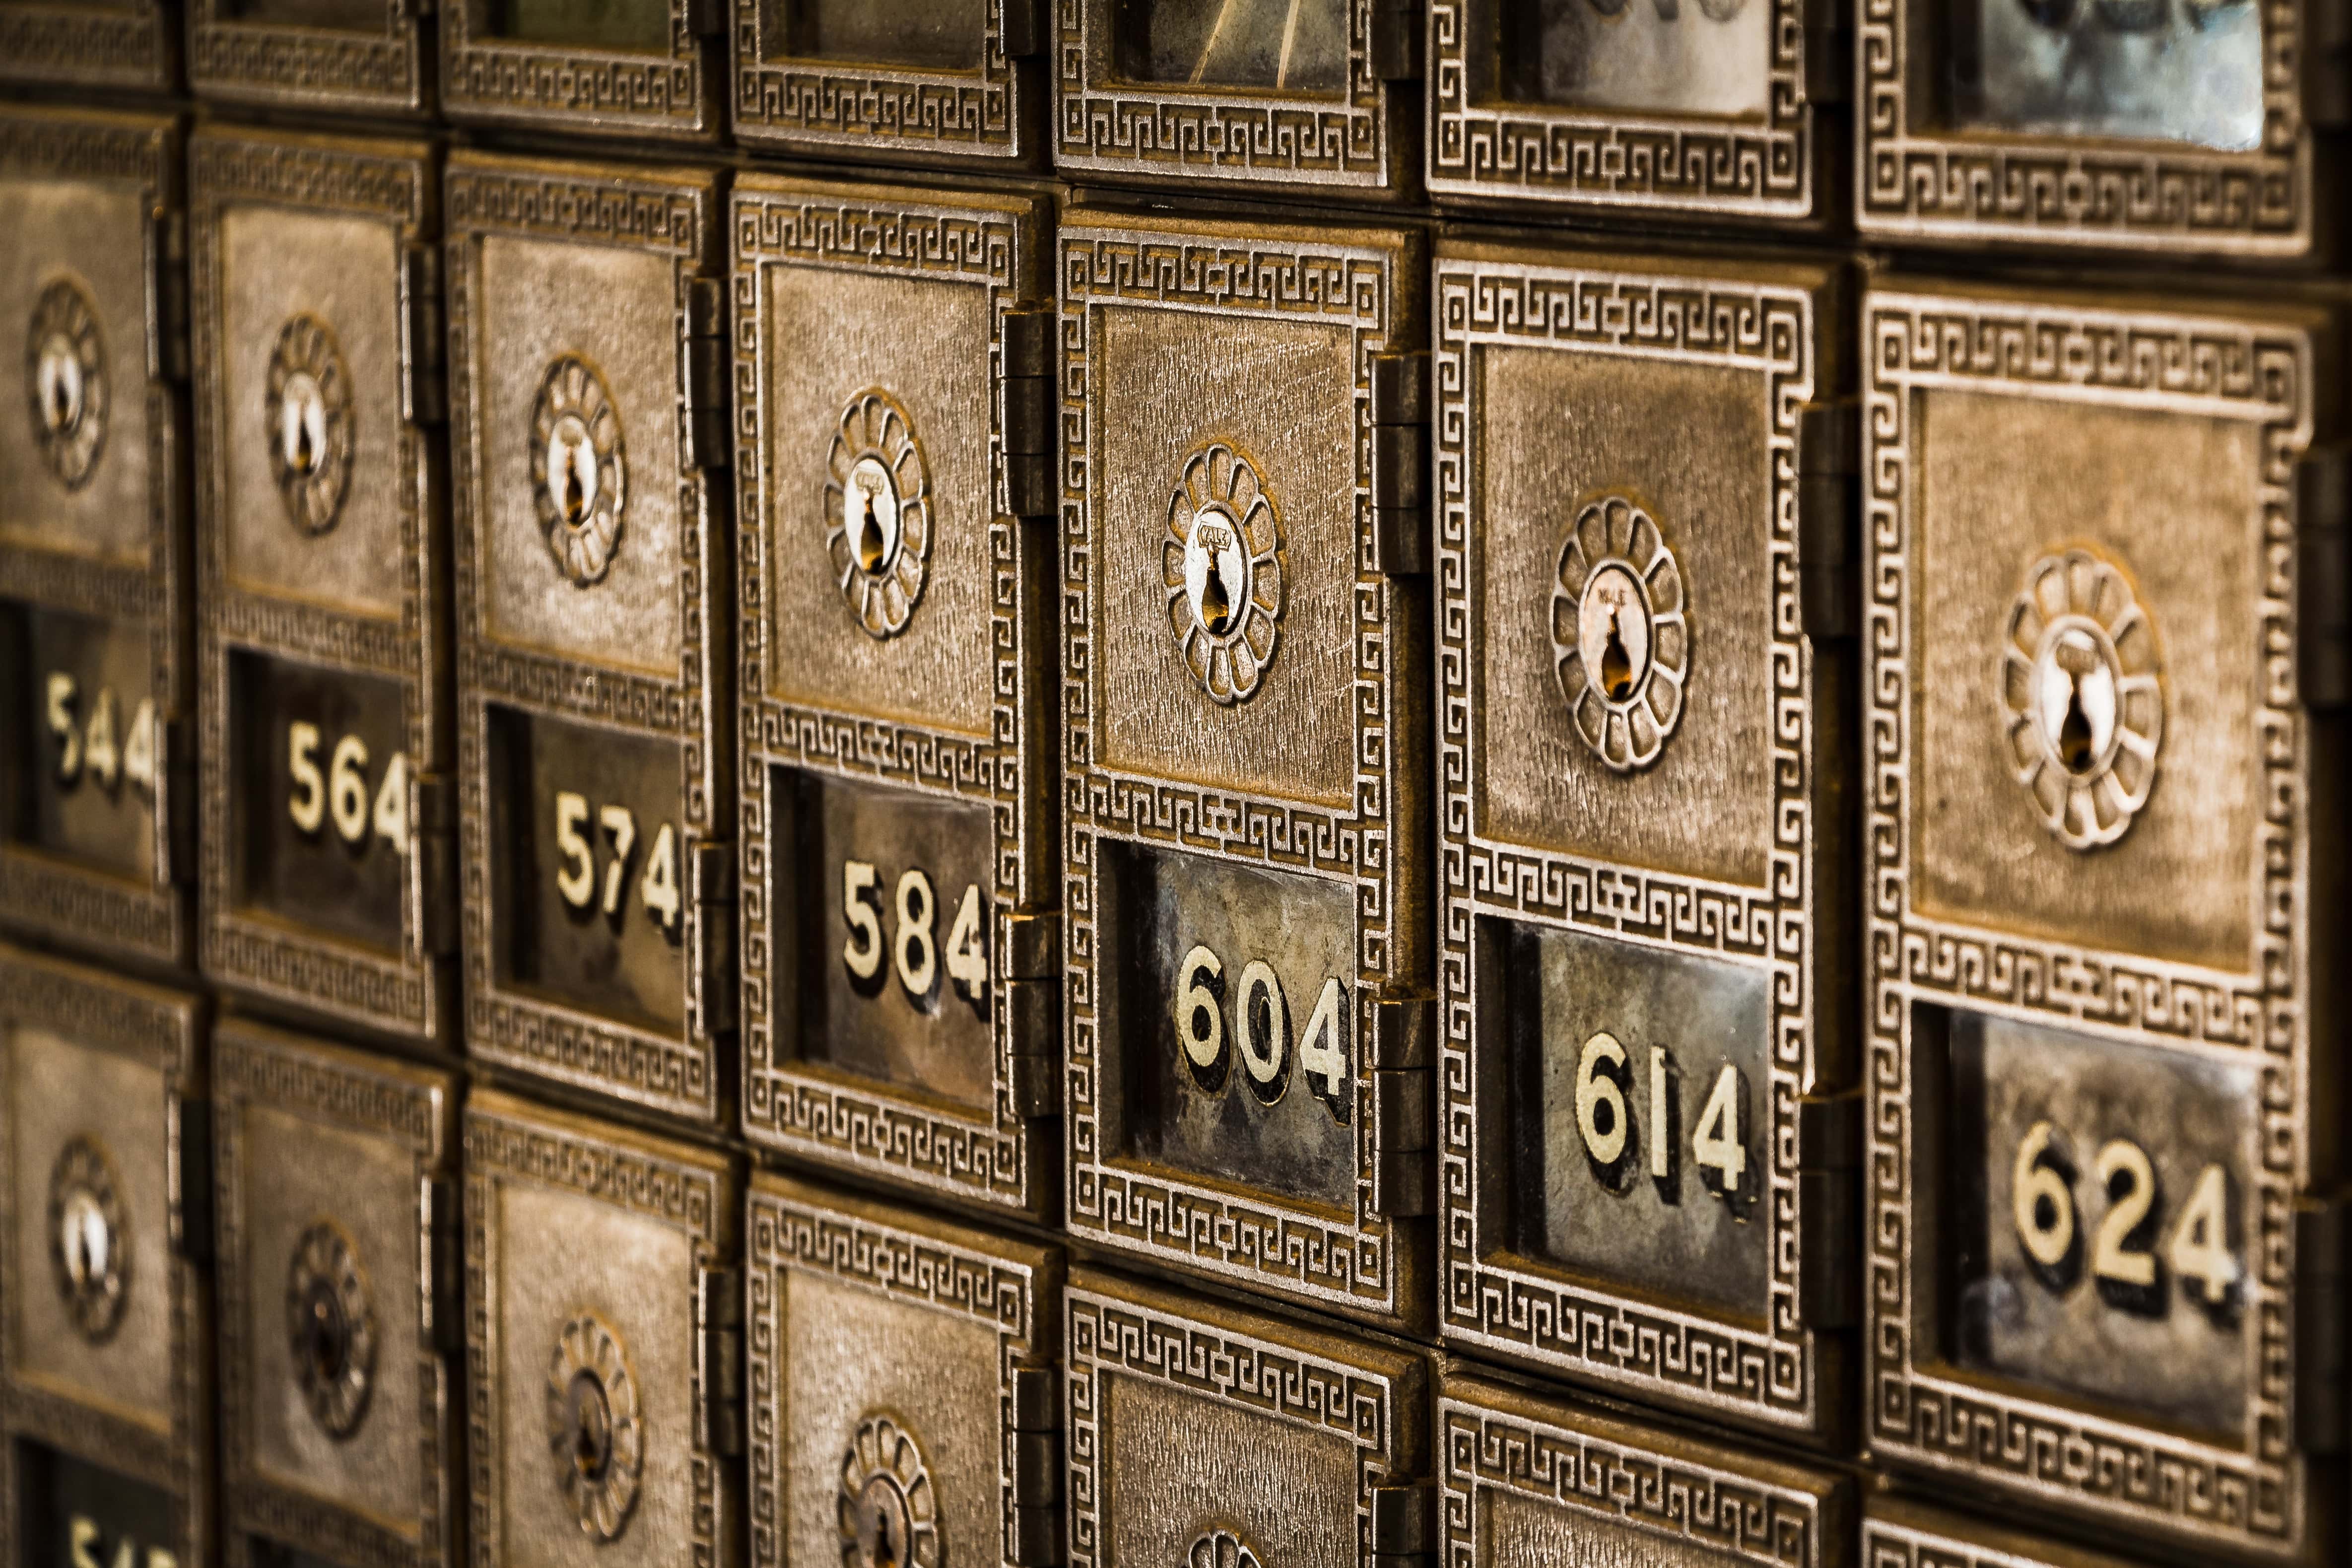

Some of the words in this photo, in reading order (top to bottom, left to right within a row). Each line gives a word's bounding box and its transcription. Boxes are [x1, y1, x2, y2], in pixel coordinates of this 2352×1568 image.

[1200, 525, 1228, 546] YALE
[47, 670, 155, 787] 544
[289, 720, 409, 855] 564
[556, 791, 680, 928] 574
[843, 860, 987, 999] 584
[1176, 945, 1347, 1096] 604
[1575, 1032, 1746, 1191] 614
[2013, 1120, 2237, 1303] 624
